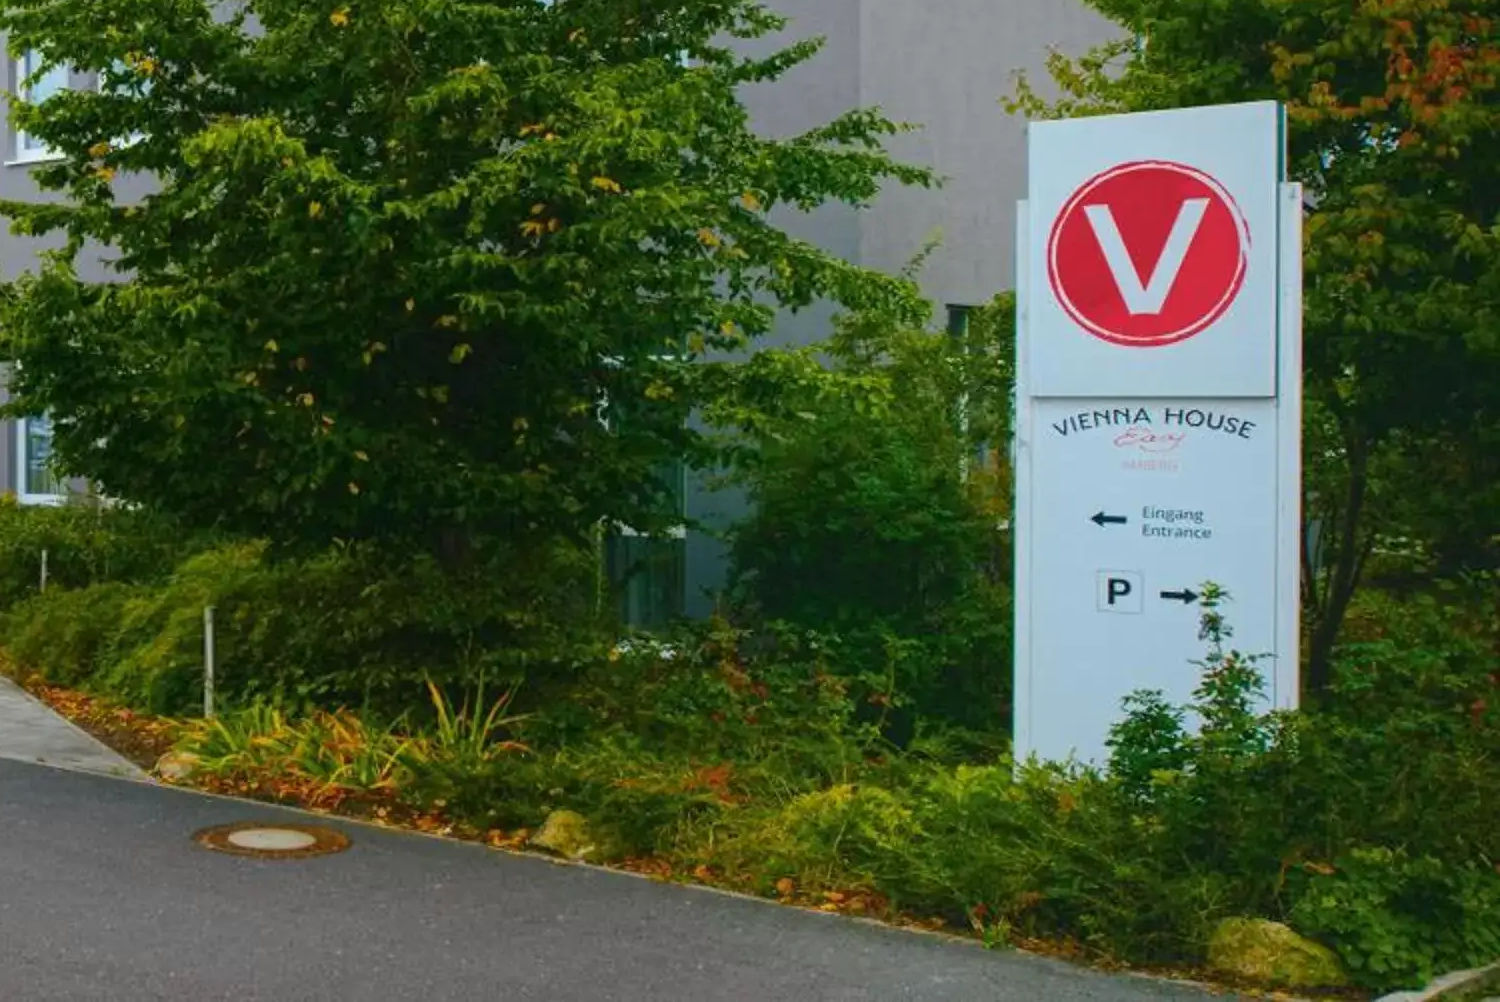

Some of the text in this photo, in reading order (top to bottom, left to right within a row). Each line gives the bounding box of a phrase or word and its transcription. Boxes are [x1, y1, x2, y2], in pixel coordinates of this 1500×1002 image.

[1083, 197, 1211, 315] V
[1052, 407, 1257, 439] VIENNA HOUSE
[1141, 506, 1204, 523] Eingang
[1141, 524, 1212, 539] Entrance
[1107, 577, 1132, 605] P
